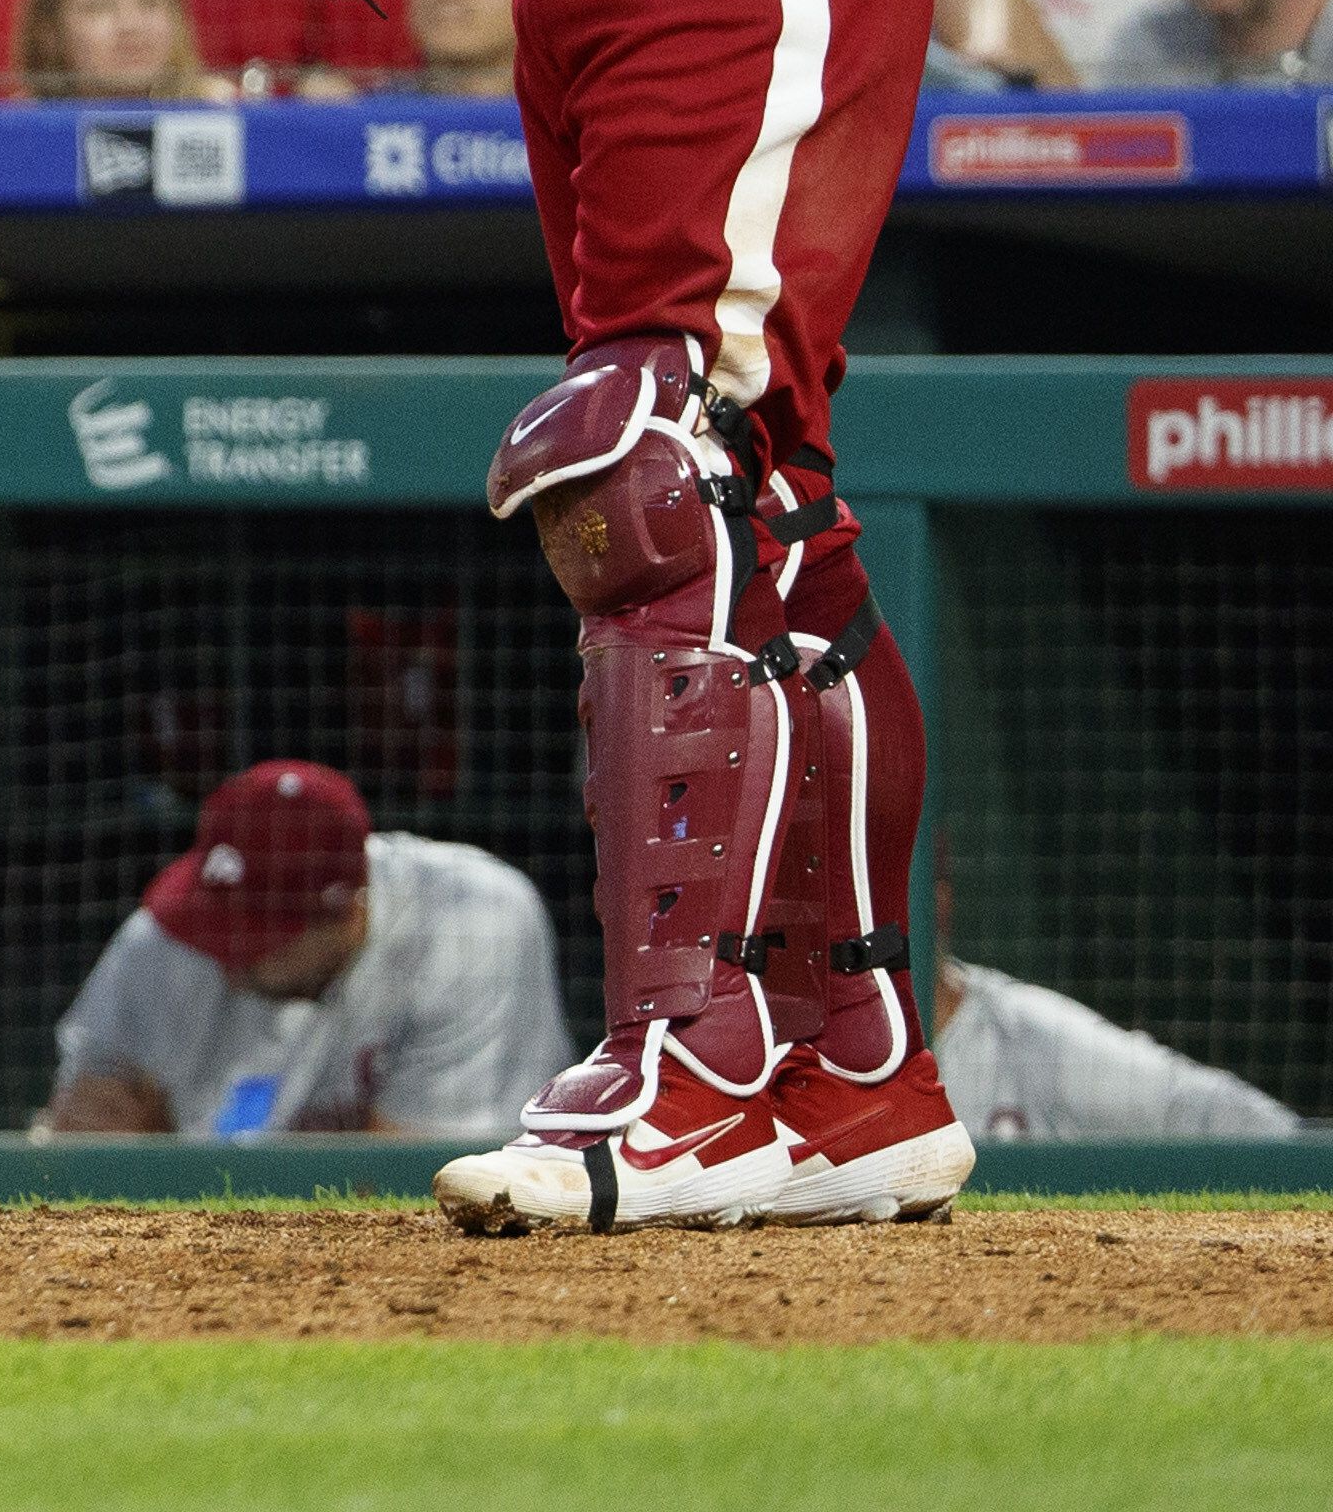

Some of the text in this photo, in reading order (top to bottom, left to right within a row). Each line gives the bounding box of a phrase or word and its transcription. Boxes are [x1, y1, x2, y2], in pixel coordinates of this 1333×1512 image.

[184, 396, 331, 434] ENERGY
[186, 439, 370, 482] TRANSFER
[1147, 394, 1333, 484] philli
